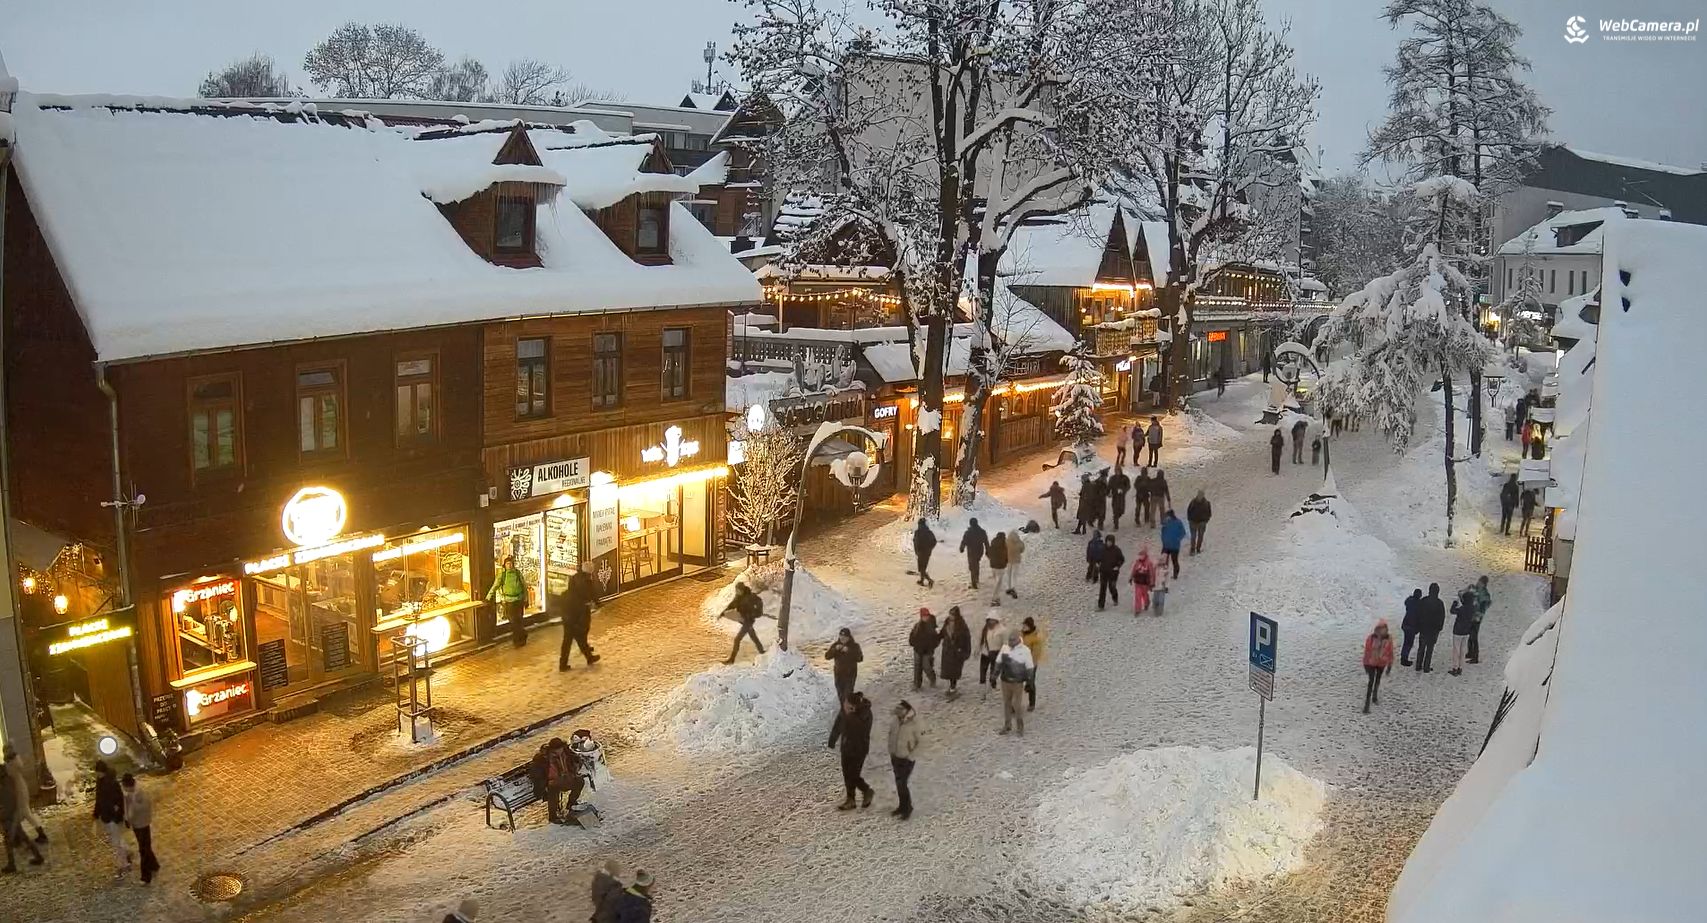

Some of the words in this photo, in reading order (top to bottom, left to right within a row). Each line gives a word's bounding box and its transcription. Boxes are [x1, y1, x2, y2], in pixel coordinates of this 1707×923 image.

[874, 405, 898, 419] GOFRY
[538, 462, 579, 483] ALKOHOLE
[188, 581, 235, 603] Grzaniec
[1256, 618, 1271, 651] P
[200, 682, 248, 706] Grzaniec
